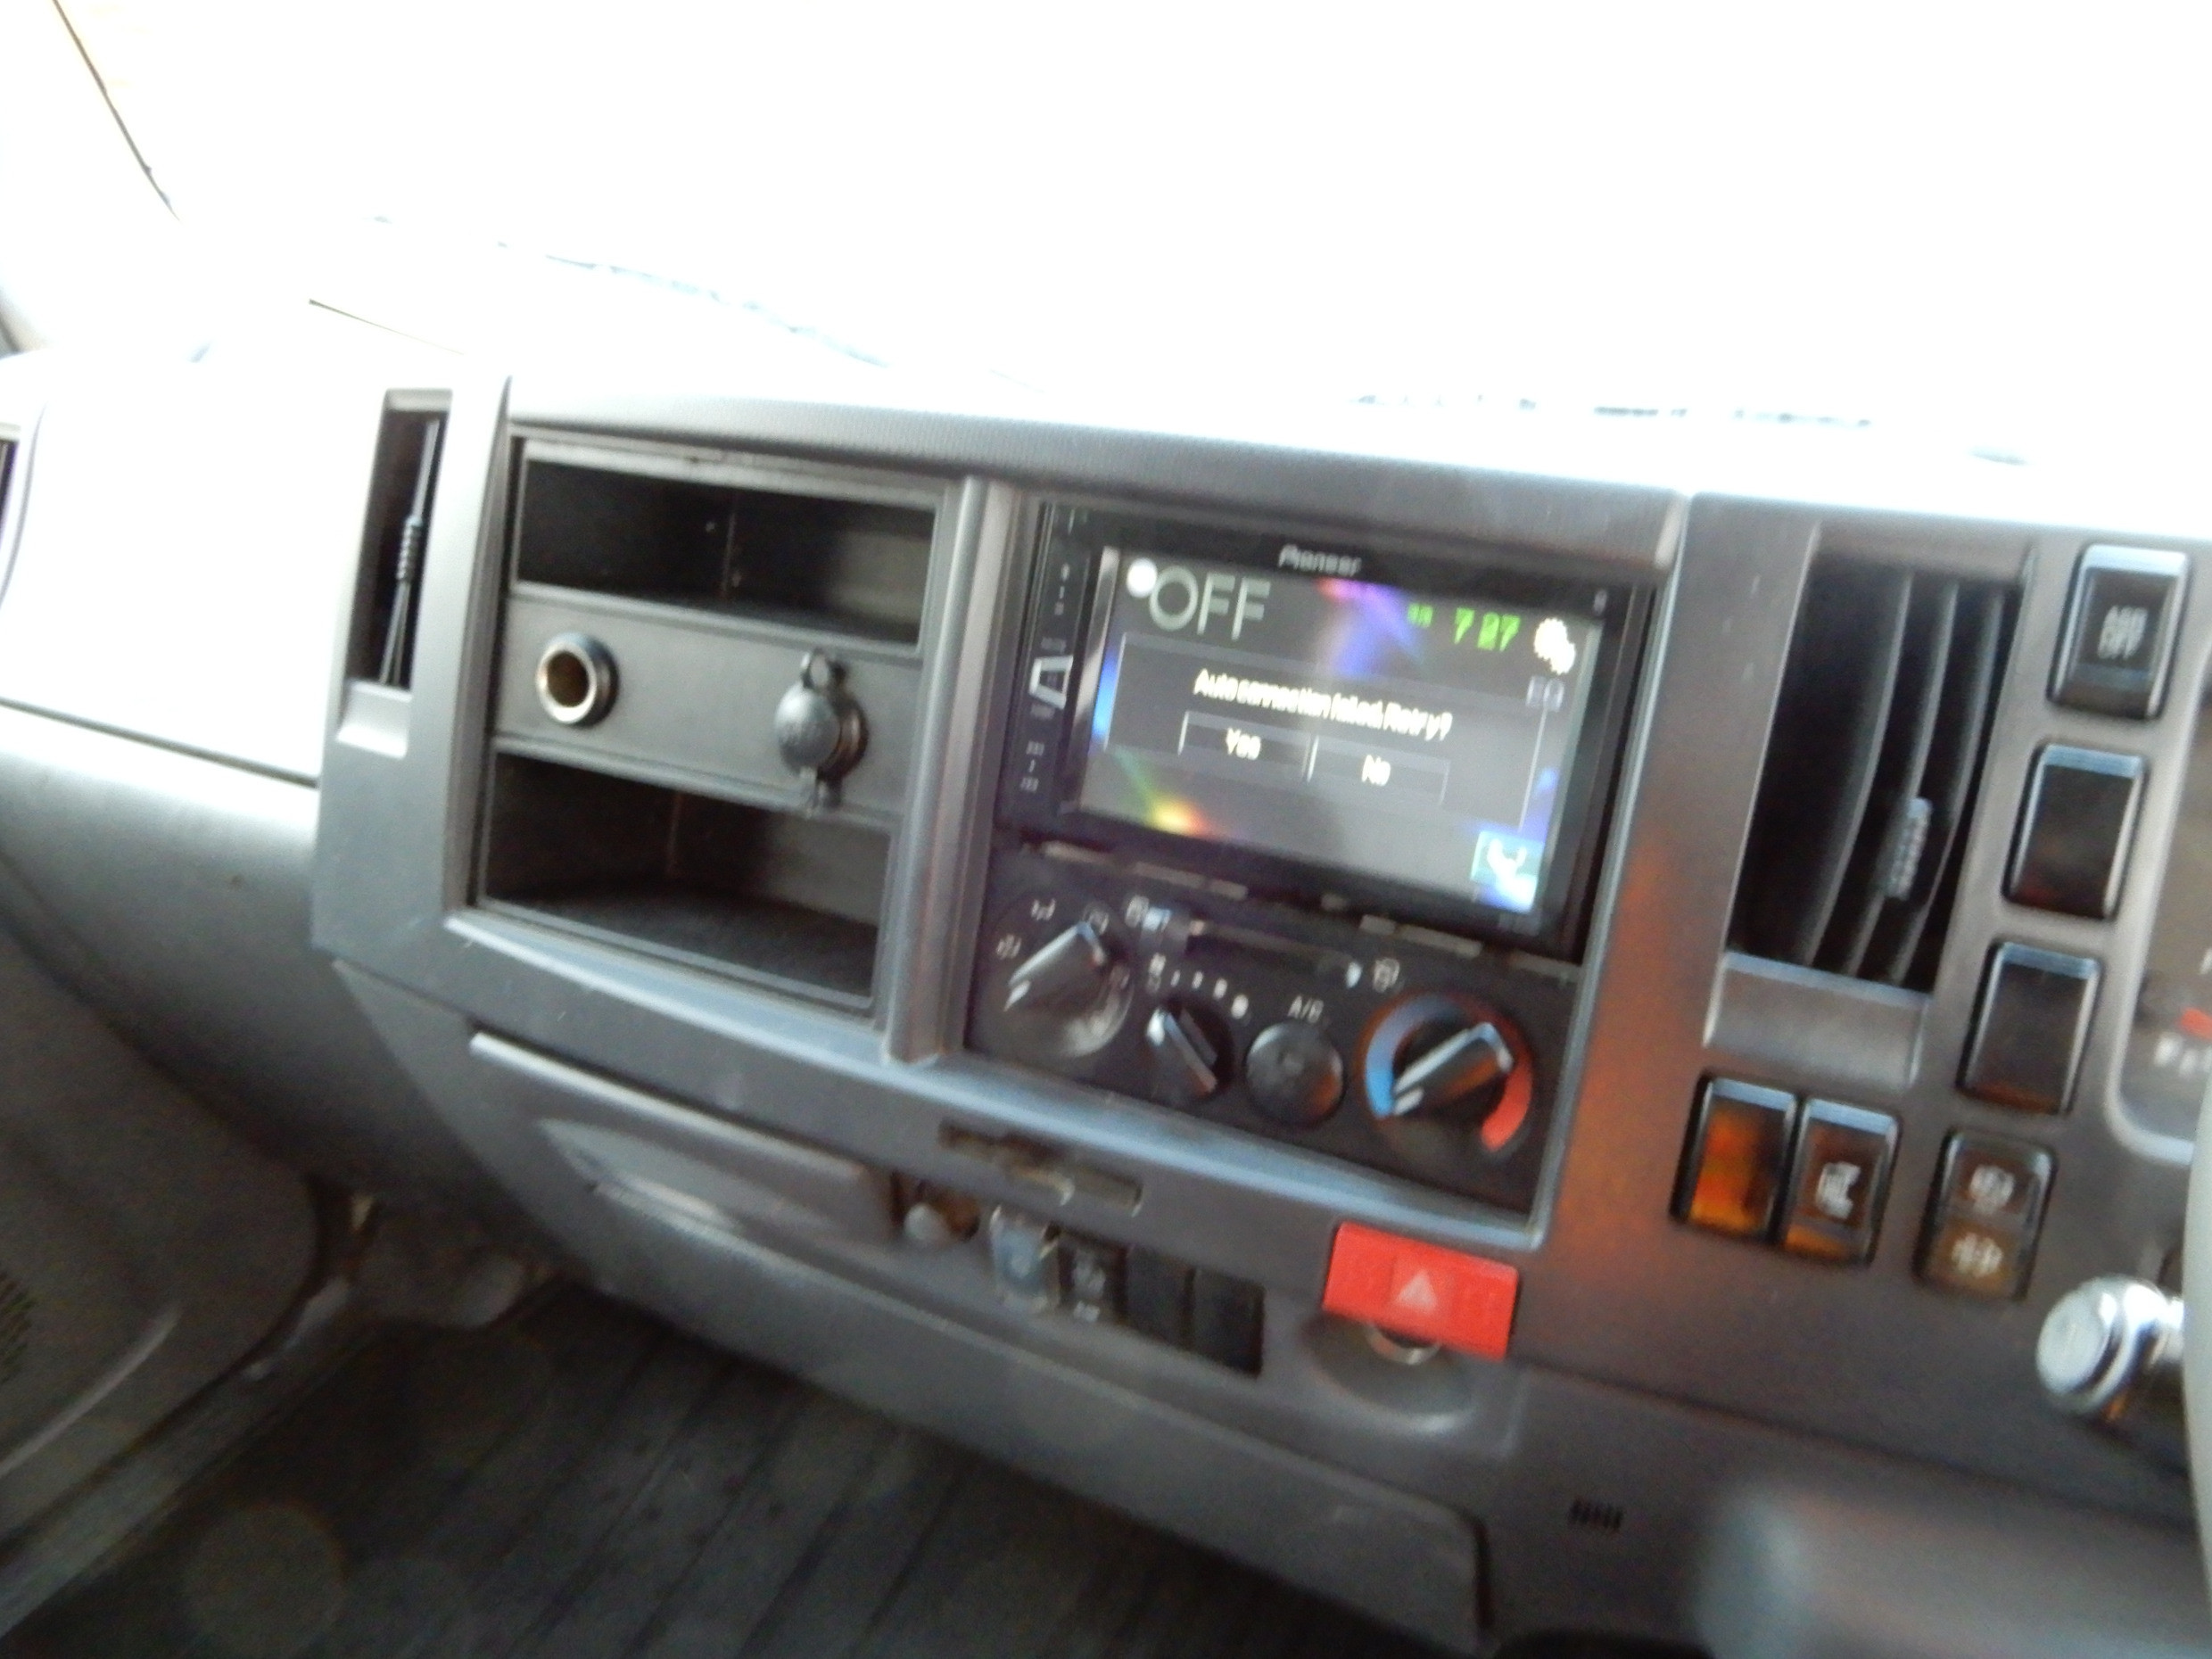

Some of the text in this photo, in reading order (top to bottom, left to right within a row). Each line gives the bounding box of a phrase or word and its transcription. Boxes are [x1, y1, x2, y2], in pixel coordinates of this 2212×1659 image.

[1149, 565, 1271, 640] OFF
[1193, 668, 1239, 702] Auto
[1382, 701, 1453, 741] Retry?
[1226, 727, 1261, 761] Yes
[1361, 754, 1391, 786] No
